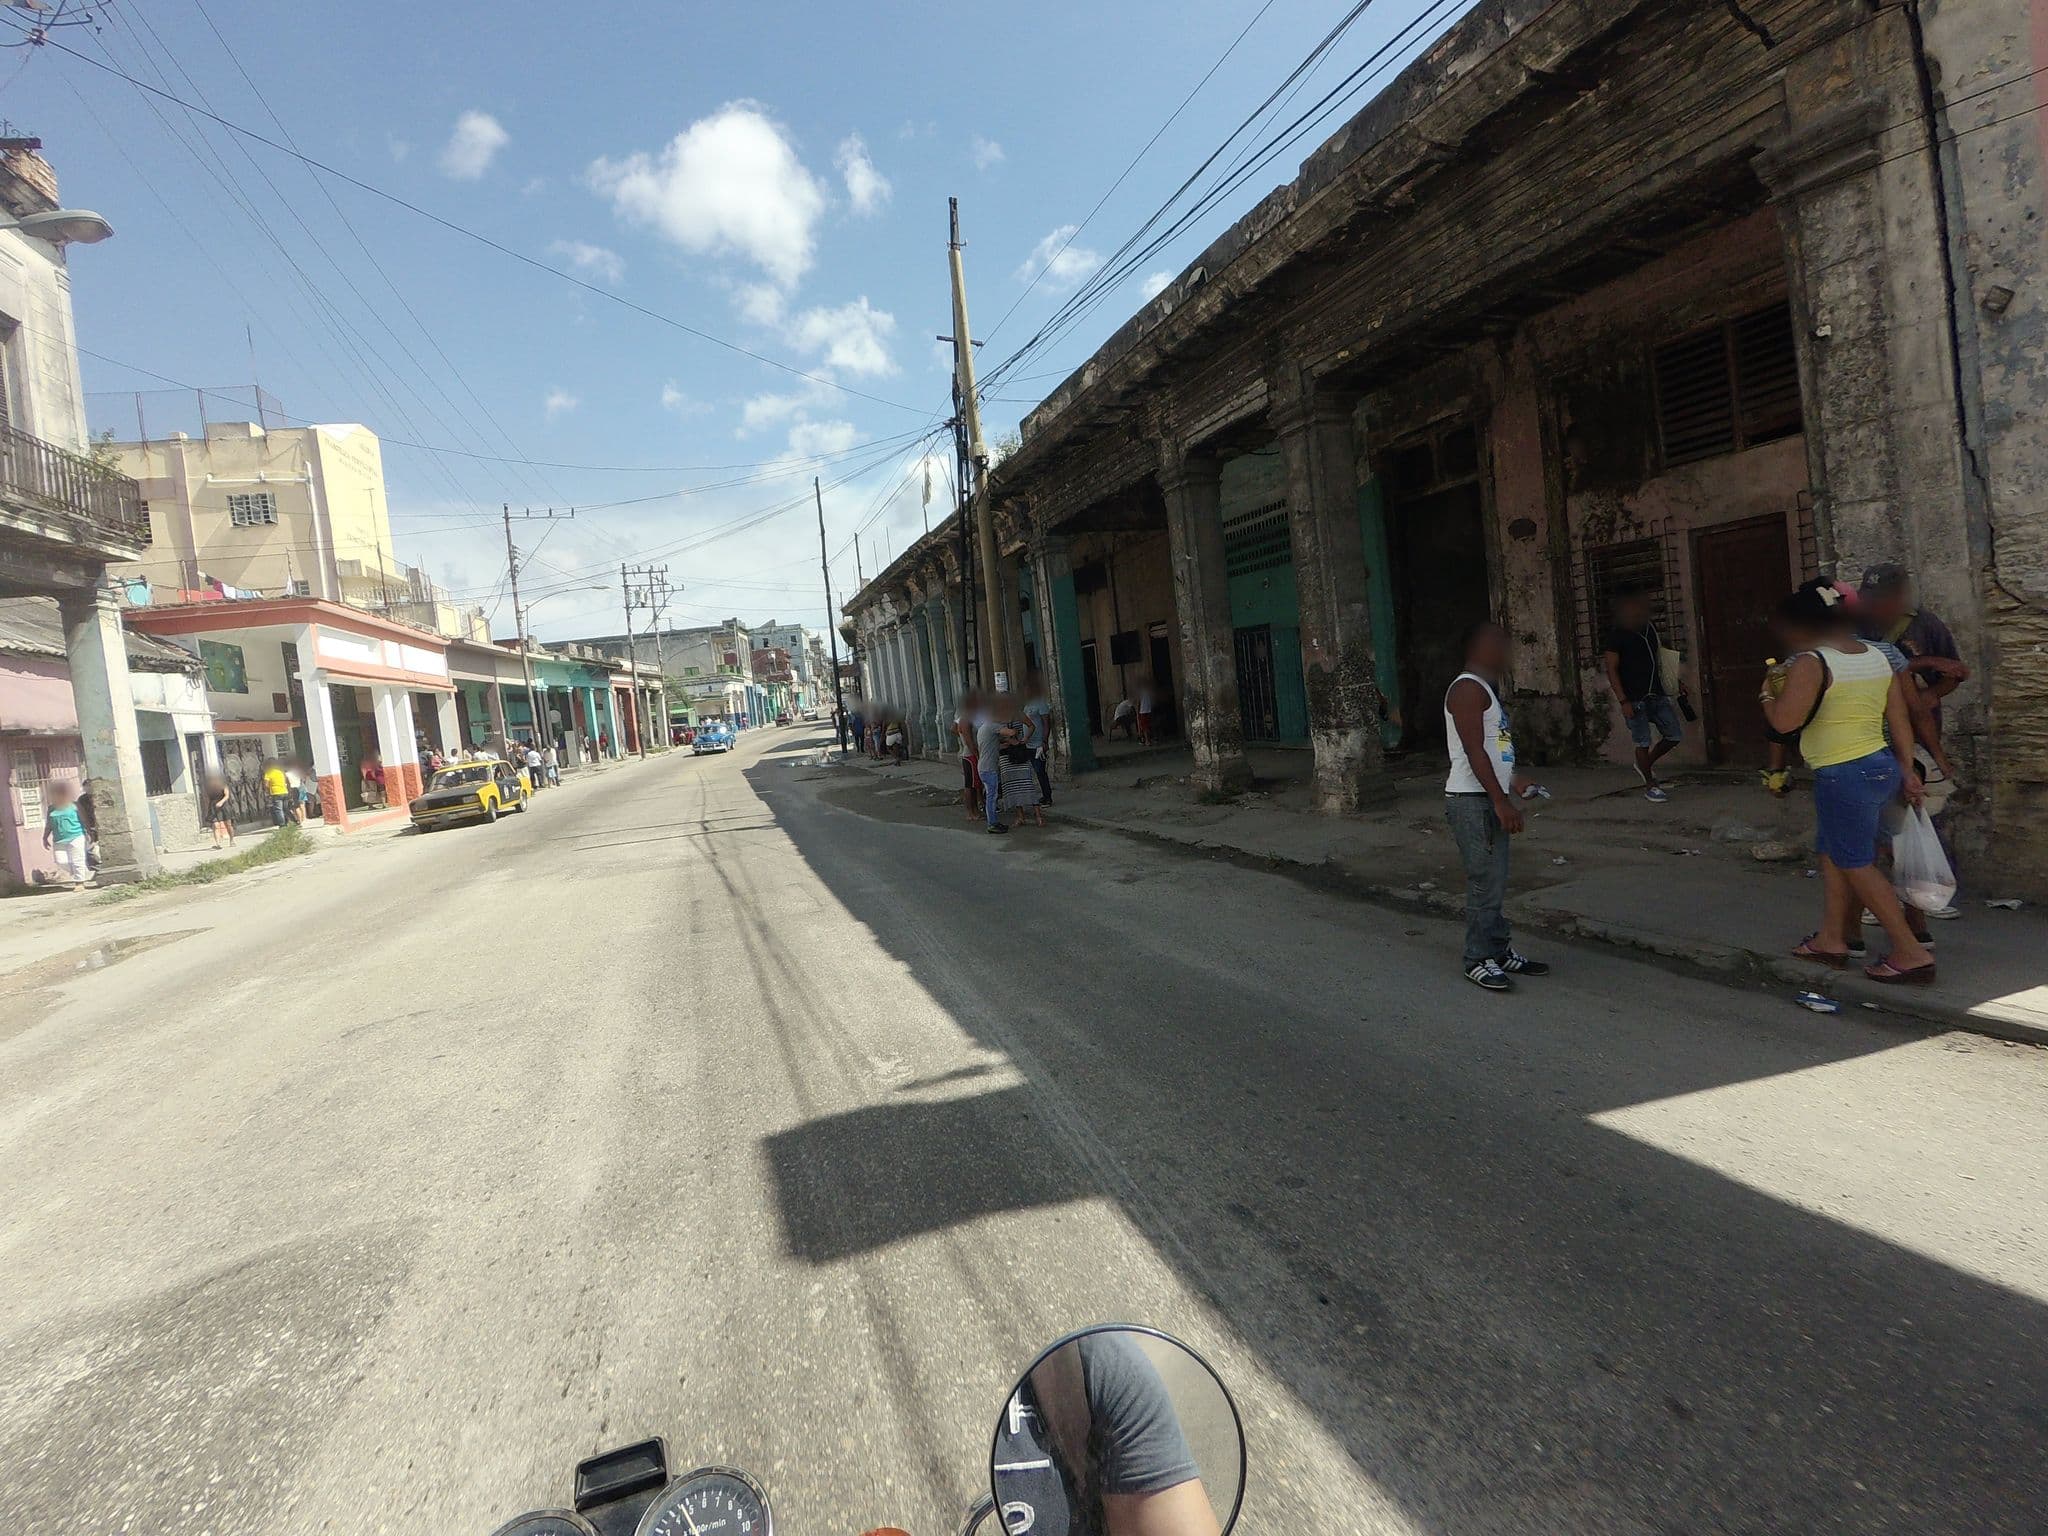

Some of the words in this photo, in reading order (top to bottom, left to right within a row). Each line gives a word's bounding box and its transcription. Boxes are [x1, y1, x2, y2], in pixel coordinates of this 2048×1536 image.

[715, 1496, 720, 1508] 7
[728, 1499, 733, 1511] 8
[689, 1504, 694, 1515] 5
[737, 1508, 743, 1520] 9
[675, 1514, 681, 1525] 4
[741, 1520, 751, 1533] 10
